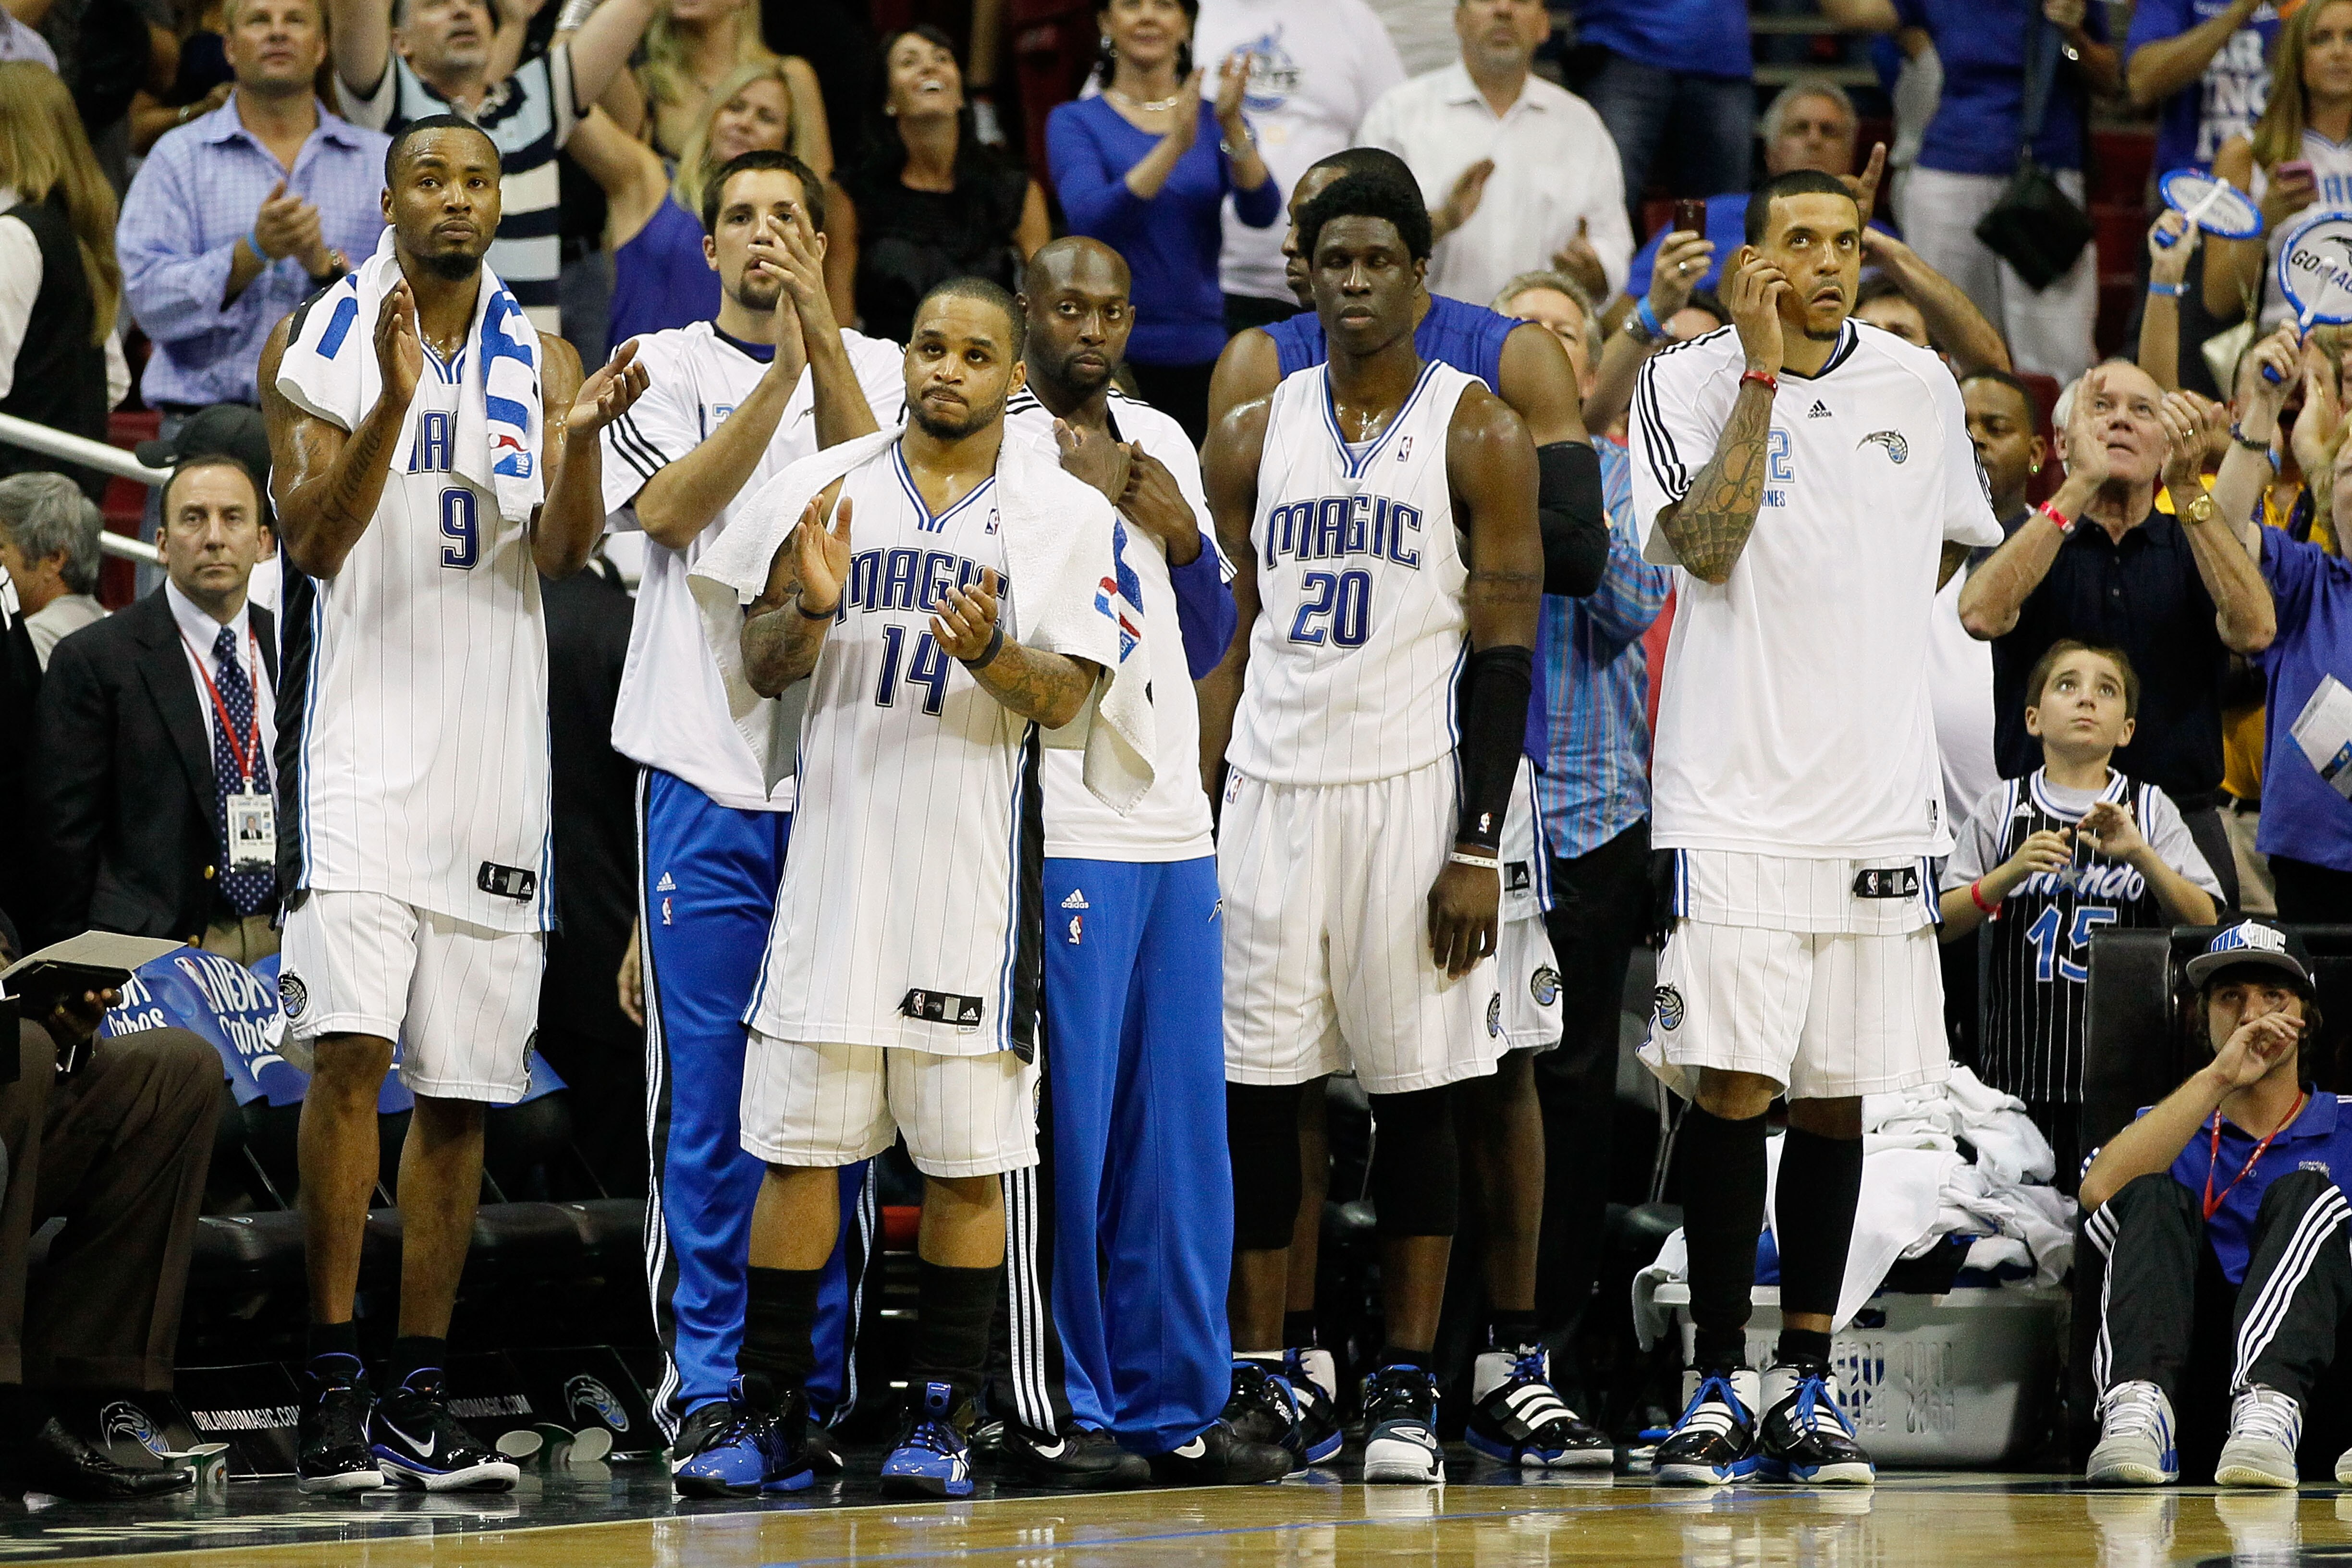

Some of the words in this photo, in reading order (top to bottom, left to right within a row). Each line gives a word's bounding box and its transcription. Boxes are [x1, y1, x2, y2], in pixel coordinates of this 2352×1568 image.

[1808, 411, 1832, 419] adidas
[439, 487, 480, 570] 9
[1265, 492, 1423, 571] MAGIC
[1761, 490, 1786, 507] RNES
[1287, 568, 1373, 648] 20
[875, 624, 954, 717] 14
[2008, 859, 2145, 902] rlndo
[2026, 903, 2118, 984] 15
[196, 955, 273, 1013] NBA
[219, 1013, 276, 1056] Care
